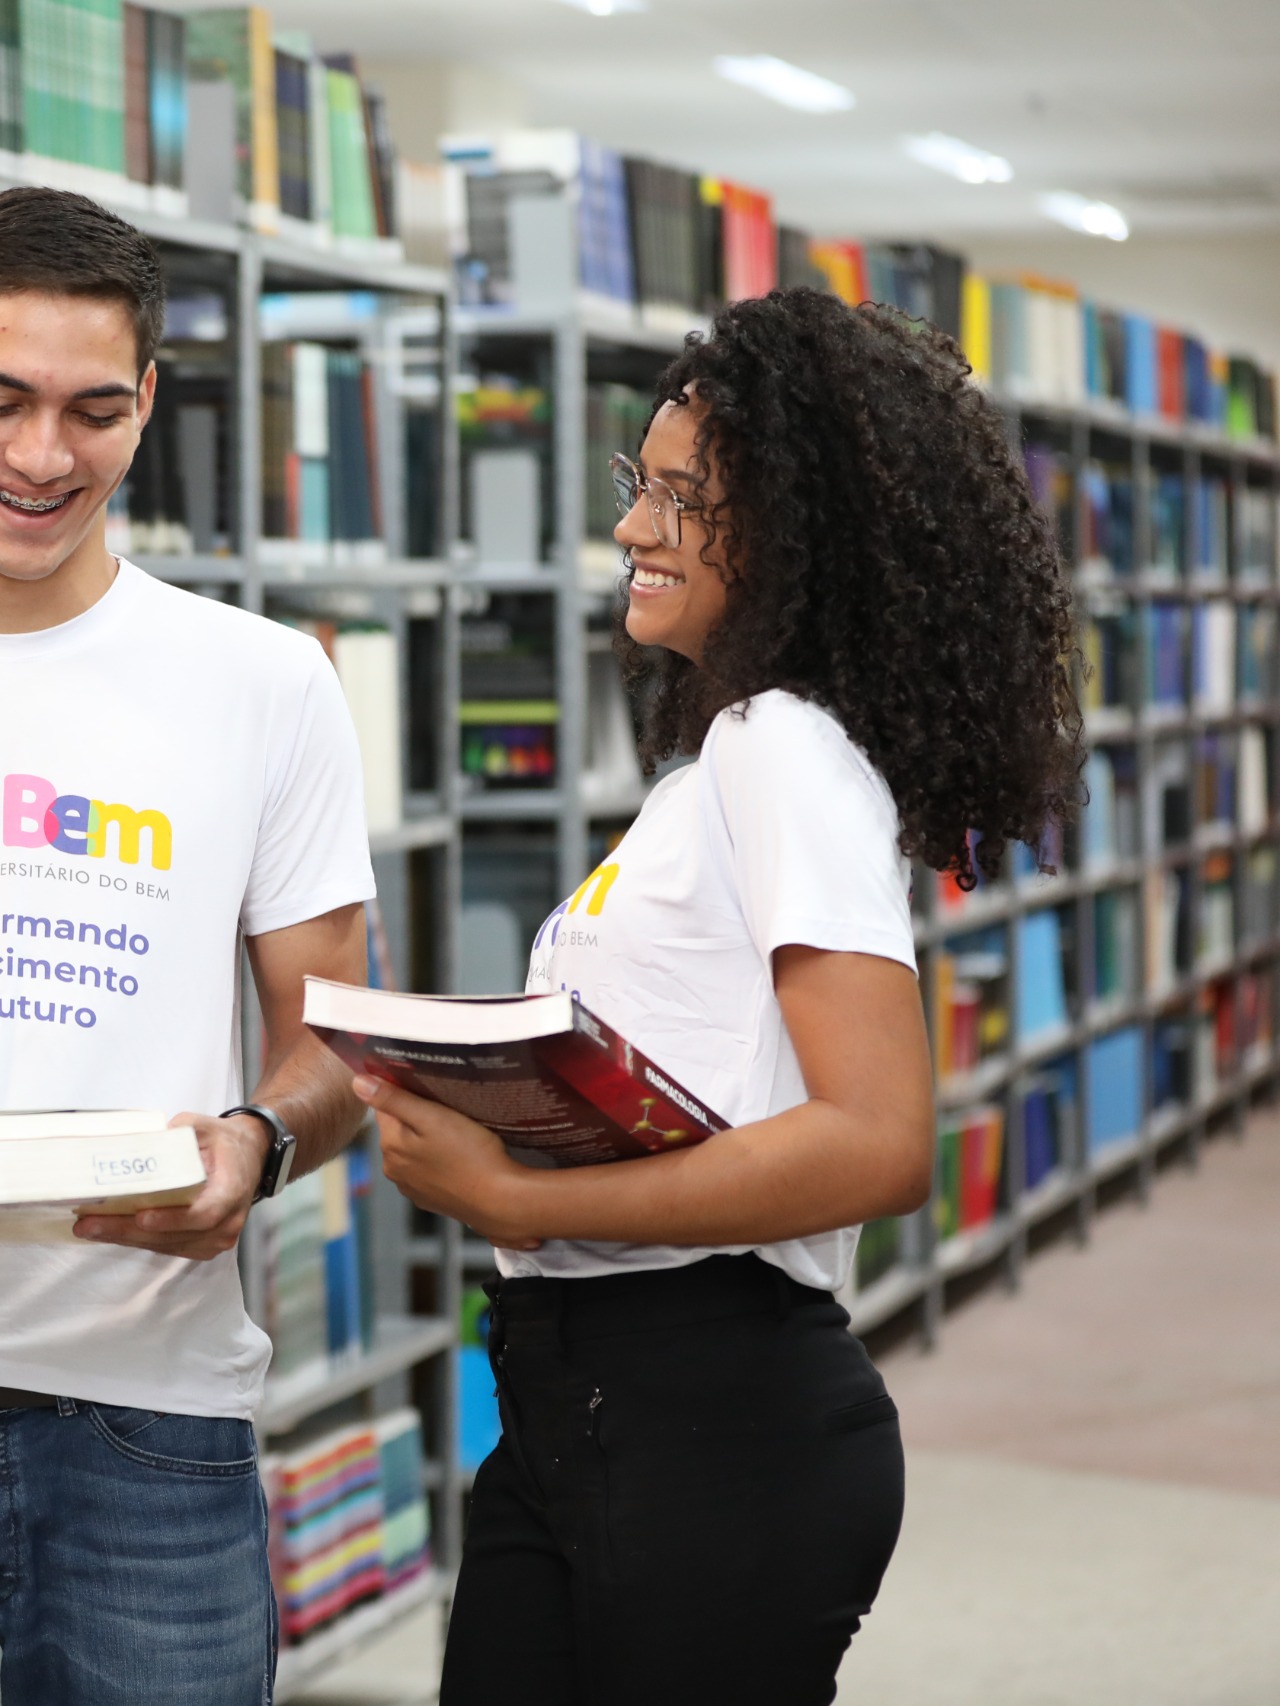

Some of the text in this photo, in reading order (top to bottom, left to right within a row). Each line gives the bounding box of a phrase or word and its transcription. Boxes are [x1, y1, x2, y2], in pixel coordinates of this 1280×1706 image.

[98, 874, 127, 892] DO
[136, 881, 170, 902] BEM
[570, 931, 599, 948] BEM
[644, 1065, 710, 1127] FARMACOLOGIA
[98, 1157, 158, 1176] FESGO
